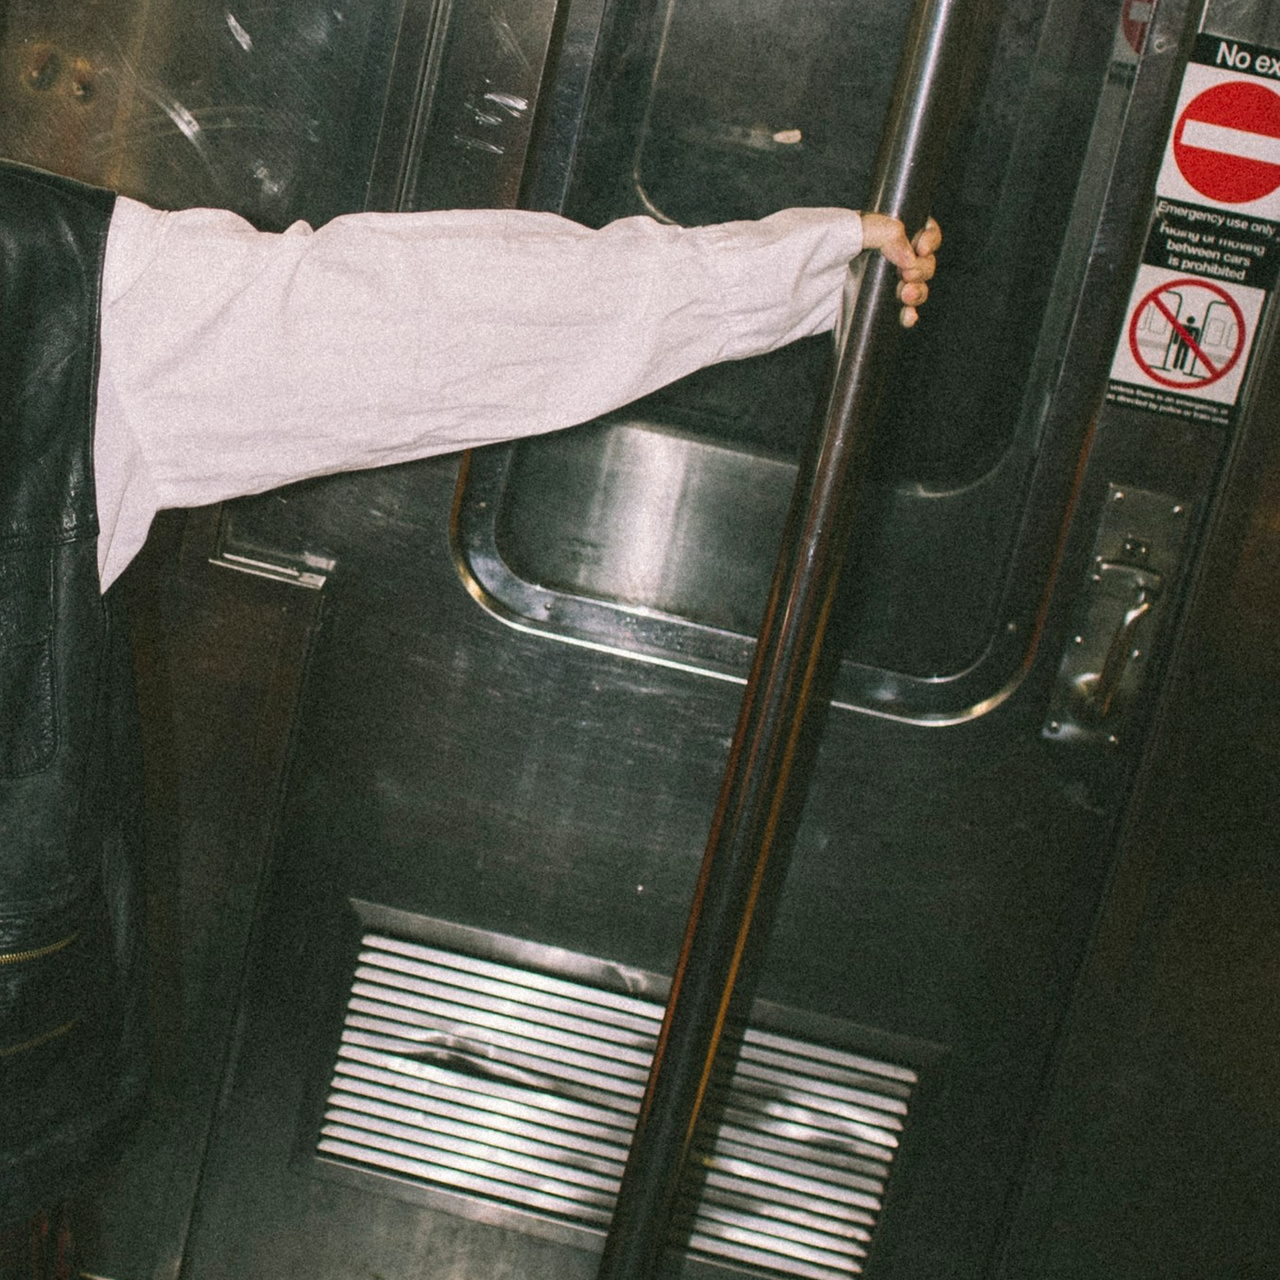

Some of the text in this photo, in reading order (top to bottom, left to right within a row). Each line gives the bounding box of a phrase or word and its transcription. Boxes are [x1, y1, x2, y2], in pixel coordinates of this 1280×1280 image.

[1216, 41, 1251, 69] No
[1158, 200, 1277, 237] Emergency use only
[1166, 238, 1251, 267] between cars
[1168, 254, 1247, 280] is prohibited
